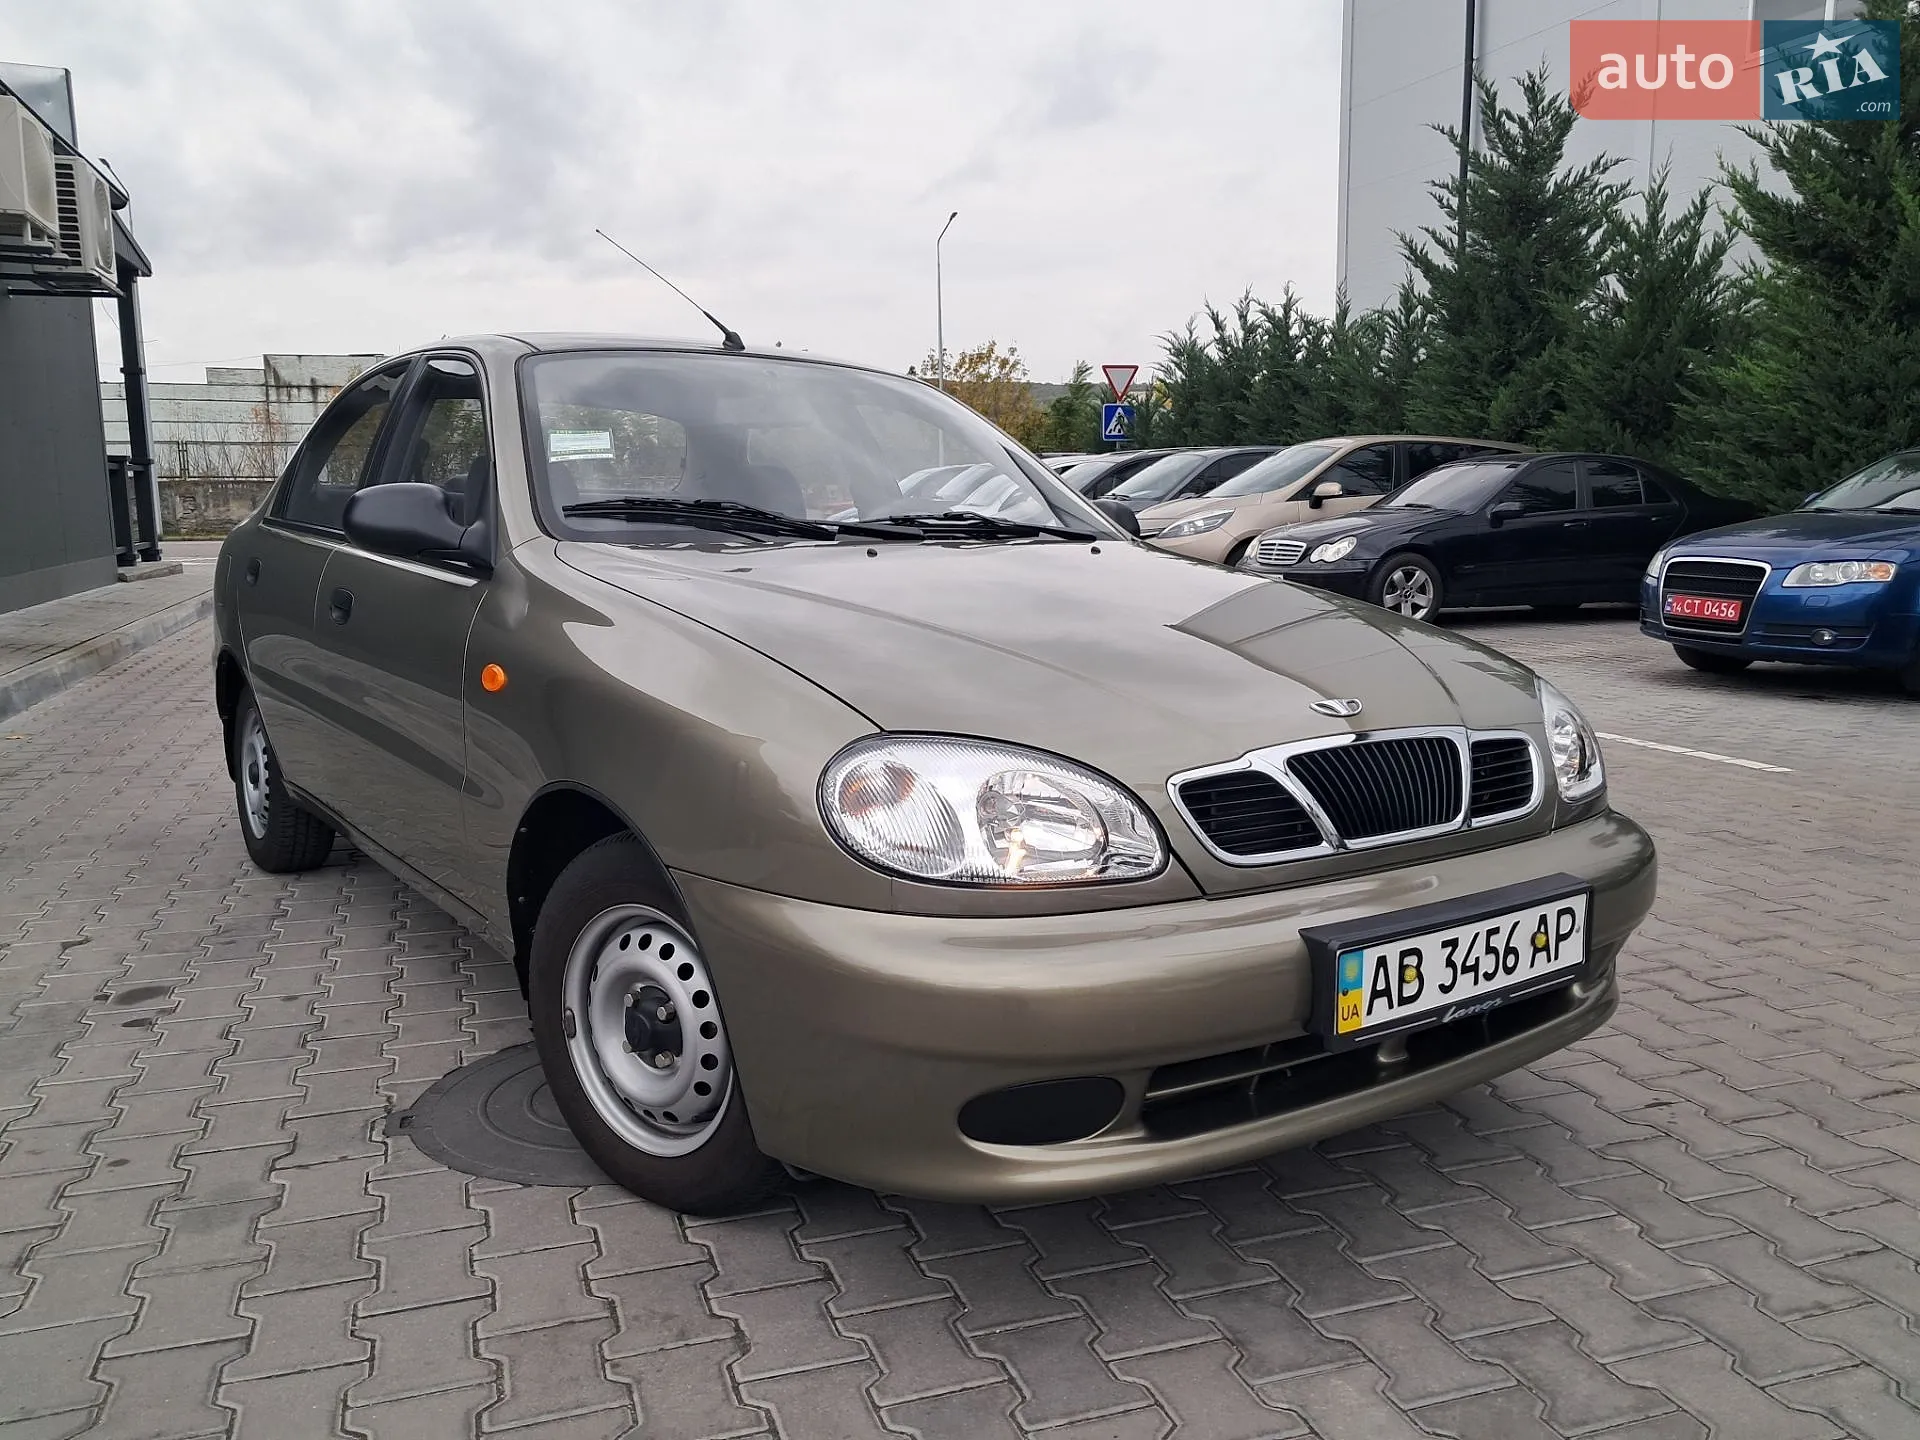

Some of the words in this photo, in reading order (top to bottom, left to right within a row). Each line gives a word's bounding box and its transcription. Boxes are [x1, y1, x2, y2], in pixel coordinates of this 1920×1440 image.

[1672, 602, 1682, 612] 14
[1683, 599, 1702, 614] CT
[1704, 601, 1737, 618] 0456
[1366, 947, 1425, 1016] AB
[1437, 920, 1521, 995] 3456
[1529, 906, 1576, 969] AP
[1341, 1002, 1360, 1021] UA
